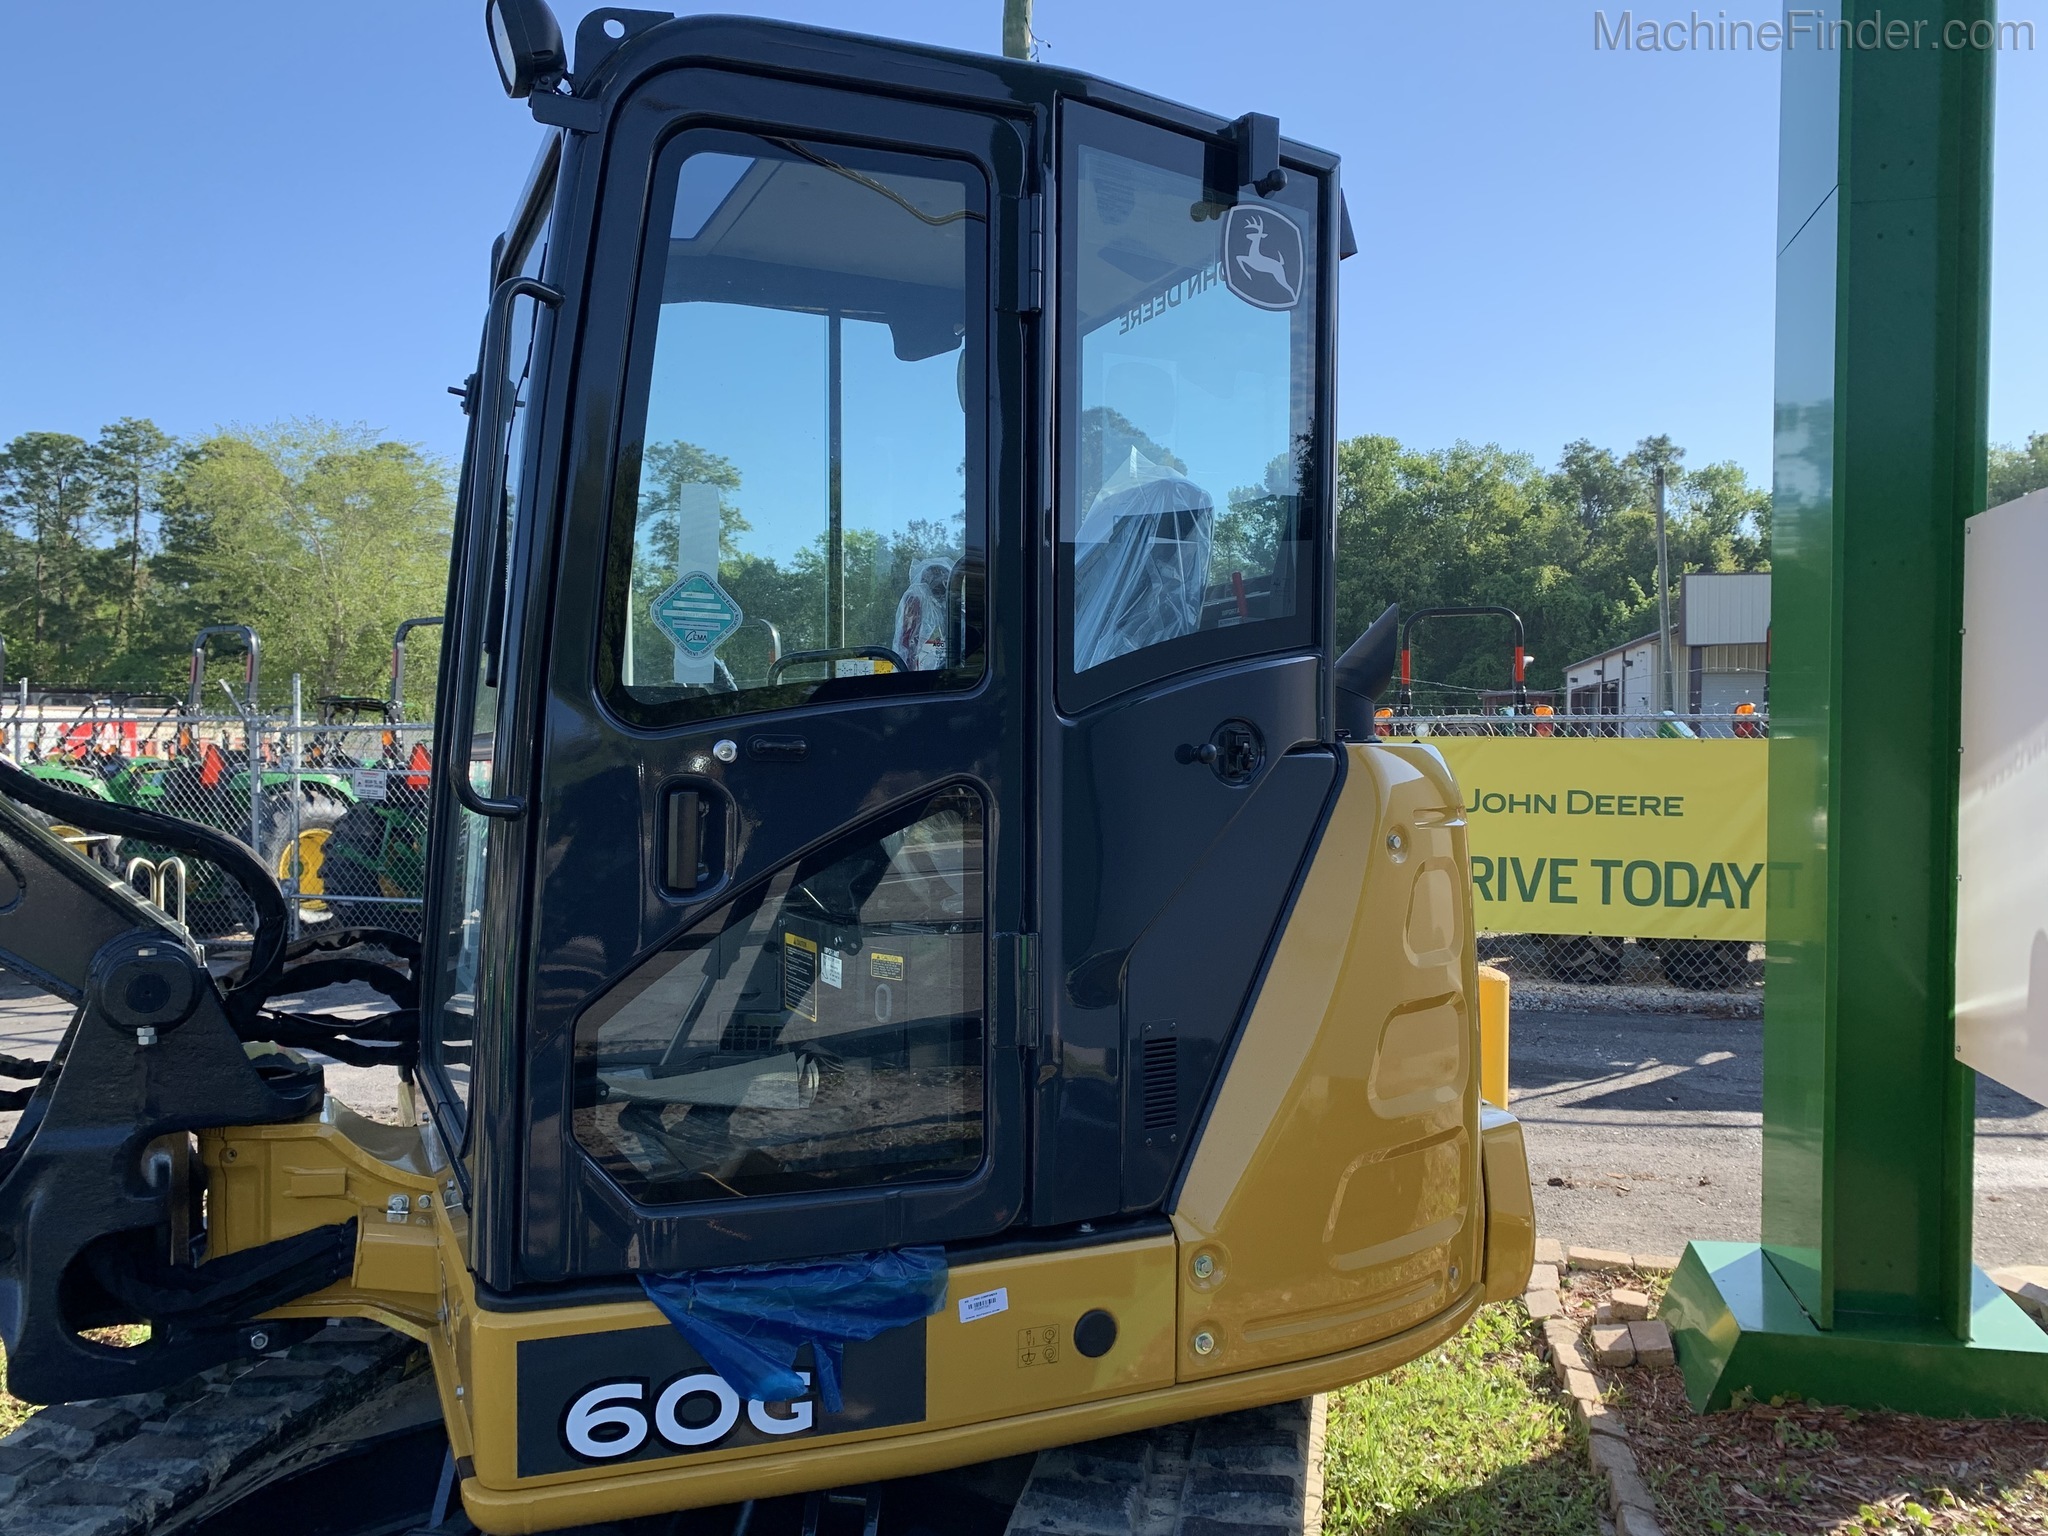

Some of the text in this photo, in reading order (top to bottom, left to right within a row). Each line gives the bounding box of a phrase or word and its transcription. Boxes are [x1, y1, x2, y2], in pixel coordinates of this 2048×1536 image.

[1466, 788, 1684, 817] JOHN DEERE
[1471, 856, 1578, 904] RIVE
[1591, 859, 1765, 909] TODAY
[565, 1371, 813, 1458] 60G
